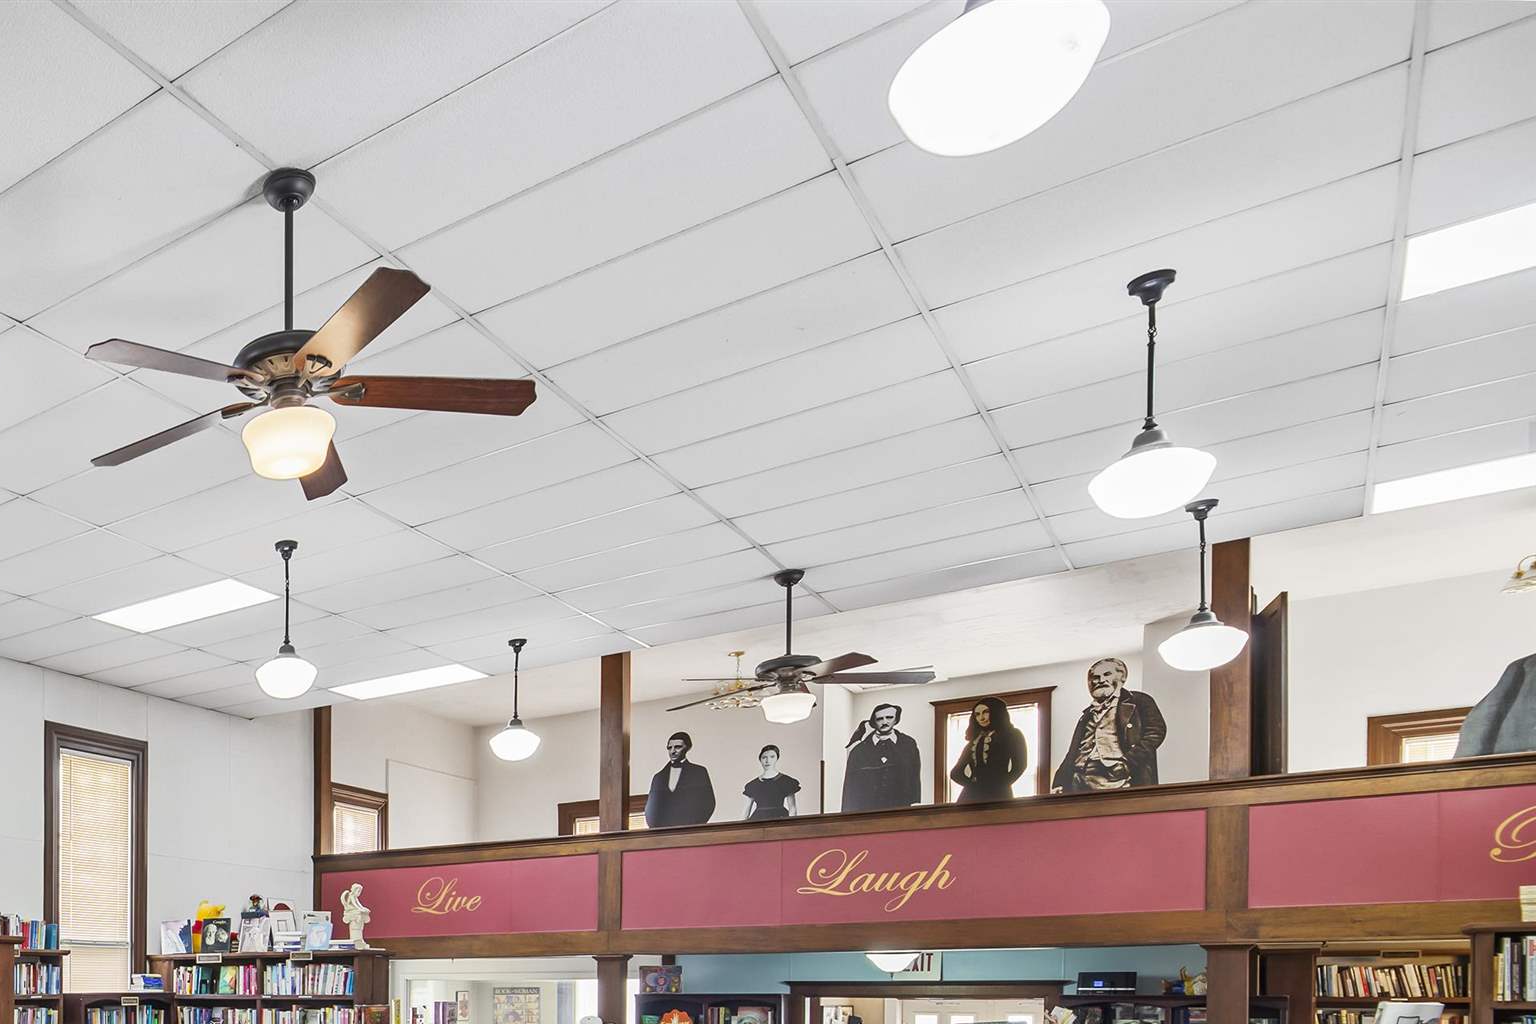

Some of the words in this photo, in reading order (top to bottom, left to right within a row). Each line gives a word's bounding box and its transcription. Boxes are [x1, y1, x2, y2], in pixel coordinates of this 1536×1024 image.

[410, 876, 484, 915] Live
[796, 848, 957, 912] Laugh
[903, 952, 934, 972] XIT
